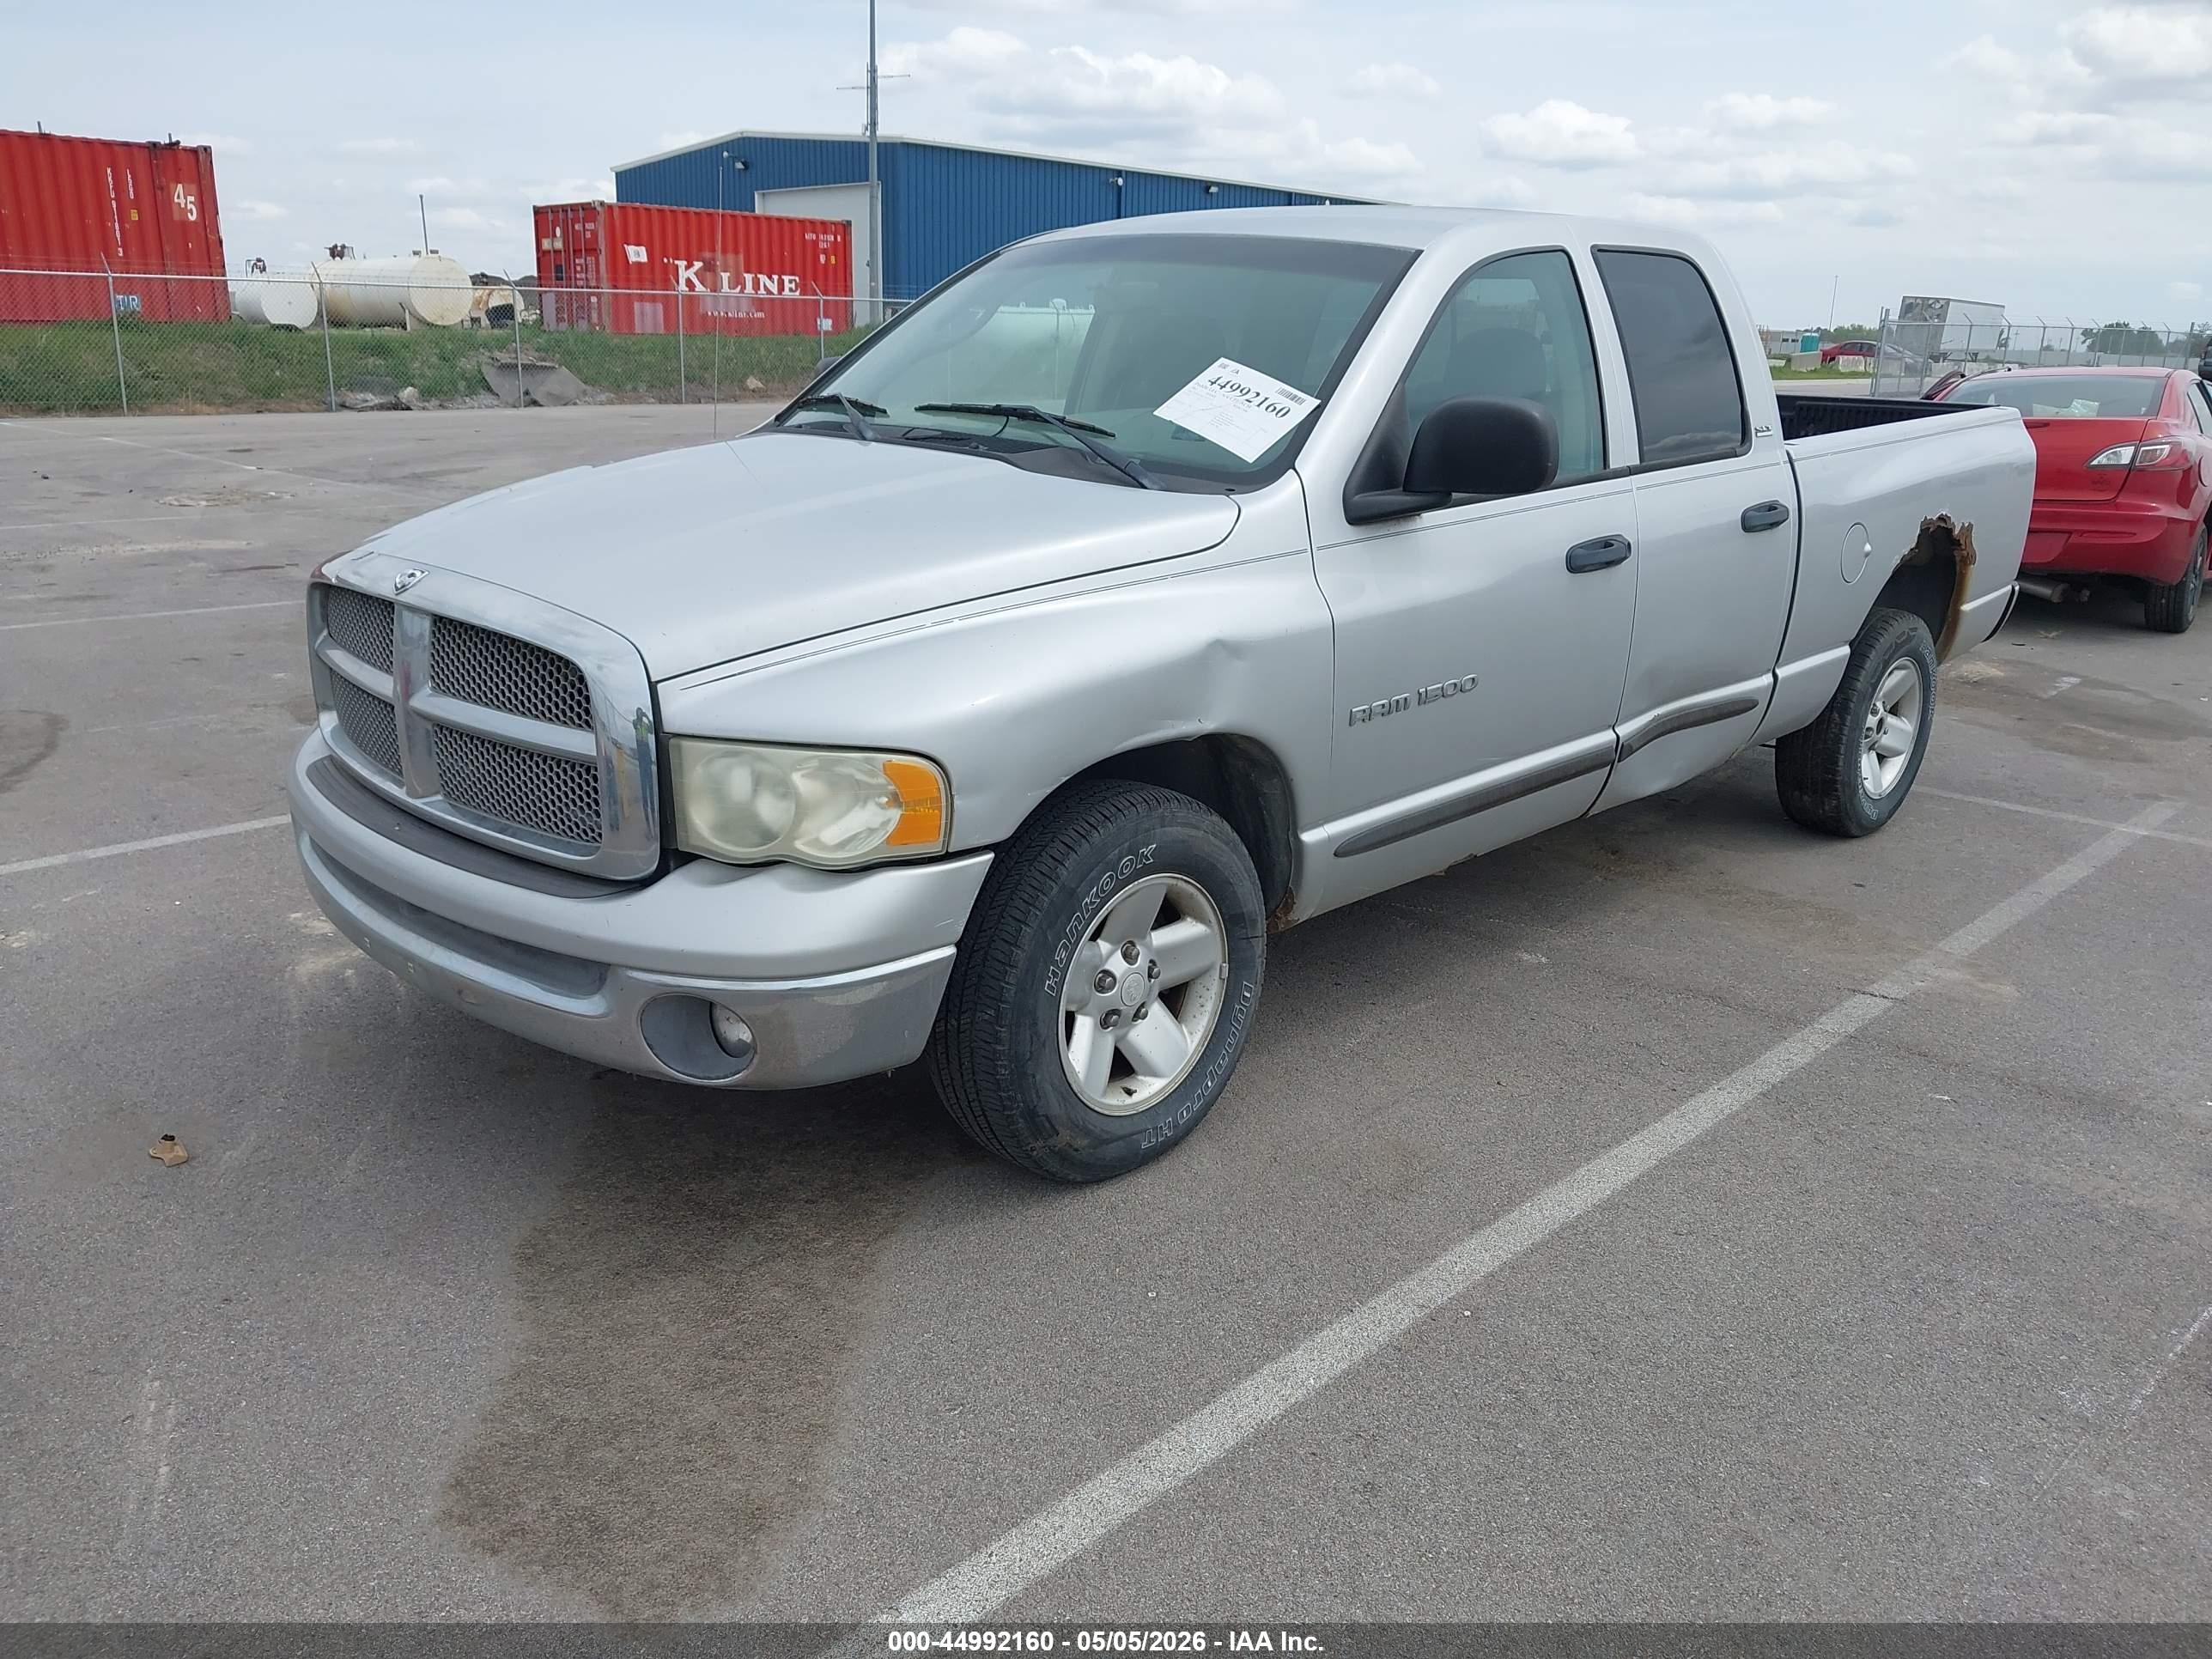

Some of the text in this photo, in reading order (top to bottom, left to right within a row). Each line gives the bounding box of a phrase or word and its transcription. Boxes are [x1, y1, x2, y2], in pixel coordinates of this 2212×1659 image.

[173, 183, 198, 221] 45
[720, 271, 800, 296] LINE
[1207, 375, 1291, 419] 44992160
[1348, 672, 1479, 727] RAM 1500
